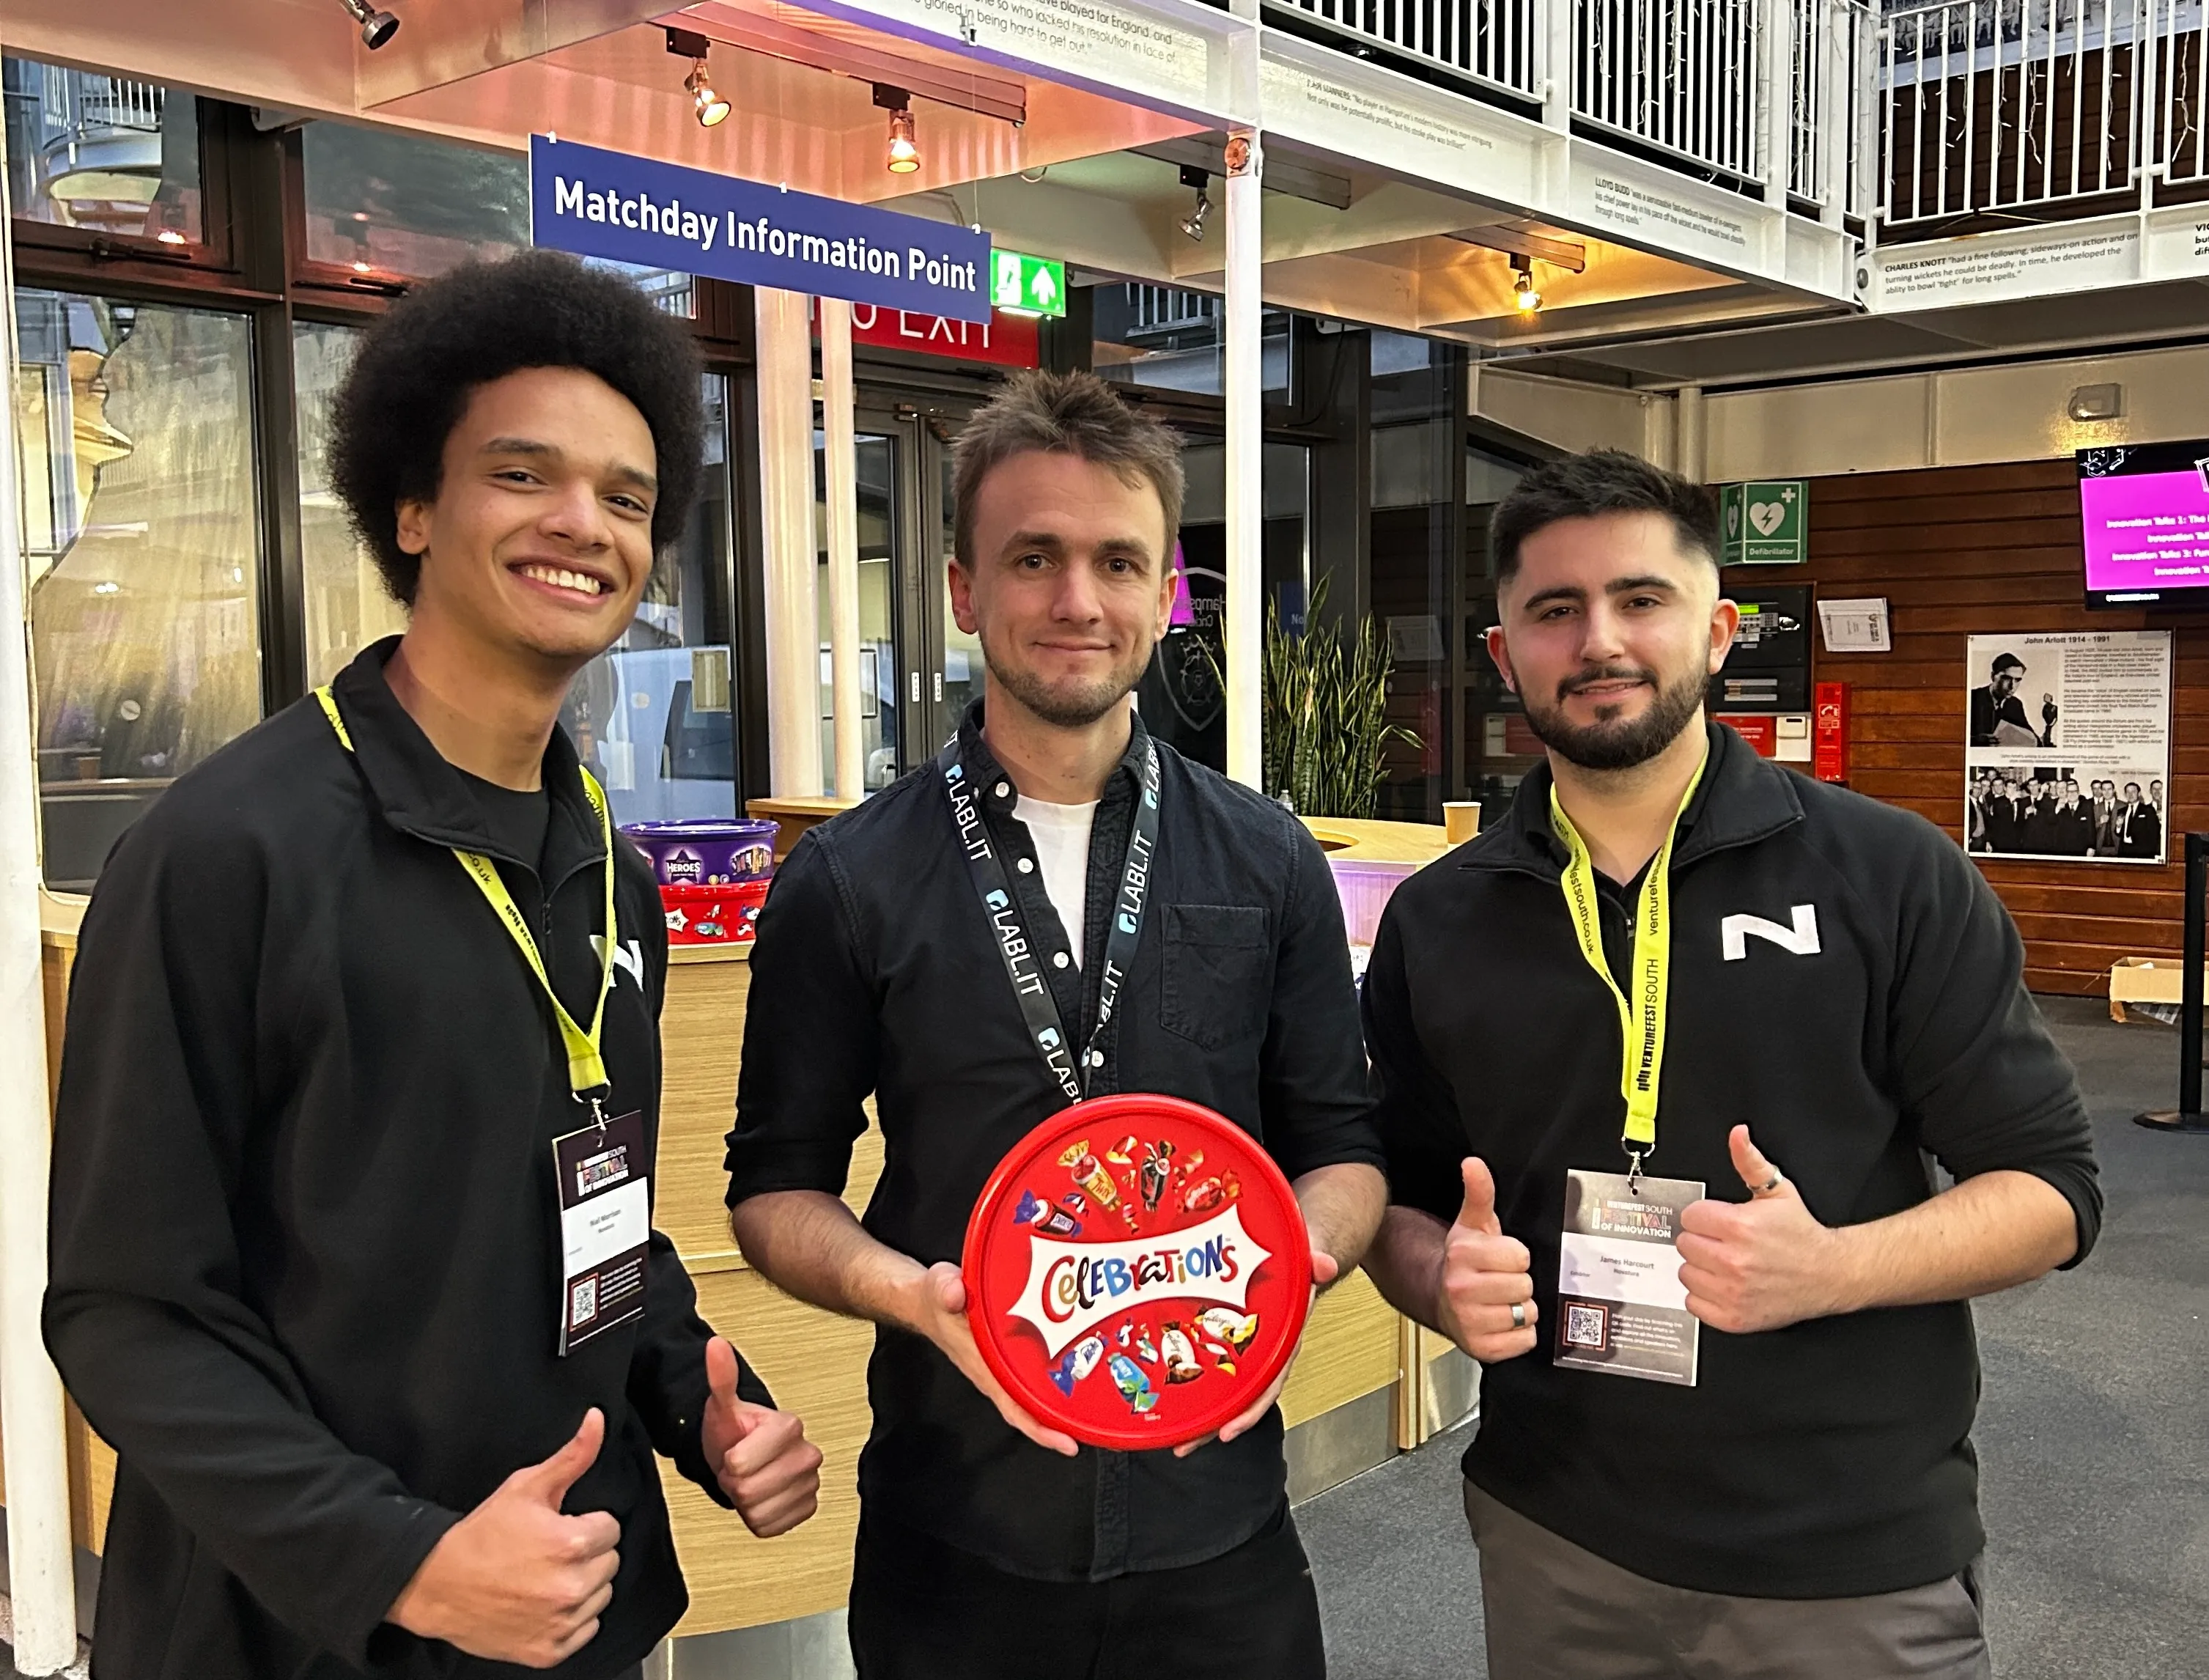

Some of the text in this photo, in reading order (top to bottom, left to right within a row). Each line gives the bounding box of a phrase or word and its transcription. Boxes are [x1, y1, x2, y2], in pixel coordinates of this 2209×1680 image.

[924, 0, 962, 15] gloried
[977, 9, 1008, 33] being
[1010, 18, 1034, 38] hard
[1037, 26, 1047, 42] to
[1049, 34, 1066, 48] get
[1011, 3, 1033, 19] who
[1087, 26, 1131, 53] resolution
[1133, 40, 1141, 54] in
[1143, 42, 1165, 60] face
[1166, 51, 1176, 63] of
[1154, 29, 1173, 45] and
[1595, 176, 1614, 191] LLOYD
[1614, 183, 1631, 196] BUDD
[1615, 199, 1631, 210] power
[1614, 210, 1625, 223] long
[555, 175, 976, 292] Matchday Information Point
[1885, 261, 1919, 273] CHARLES
[1919, 258, 1947, 268] KNOTT
[1974, 251, 1989, 261] fine
[2030, 240, 2080, 253] sideways-on
[2081, 237, 2108, 247] action
[2109, 234, 2125, 243] and
[2126, 232, 2138, 240] on
[1885, 274, 1912, 284] turning
[1914, 270, 1942, 281] wickets
[1943, 268, 1953, 276] he
[1955, 265, 1976, 275] could
[1977, 263, 1987, 272] be
[2050, 254, 2061, 263] he
[2062, 248, 2106, 261] developed
[2106, 247, 2122, 255] the
[1917, 281, 1936, 291] bowl
[1962, 276, 1974, 285] for
[1975, 274, 1992, 284] long
[1749, 547, 1795, 556] Defibrillator
[2093, 635, 2110, 643] 1991
[949, 780, 992, 861] LABL.IT
[666, 861, 701, 873] HEROES
[1121, 829, 1152, 914] LABL.IT
[993, 910, 1044, 995] LABL.IT
[1601, 1208, 1672, 1230] FESTIVAL
[1600, 1222, 1672, 1239] OF INNOVATION
[1600, 1255, 1655, 1270] James Harcourt
